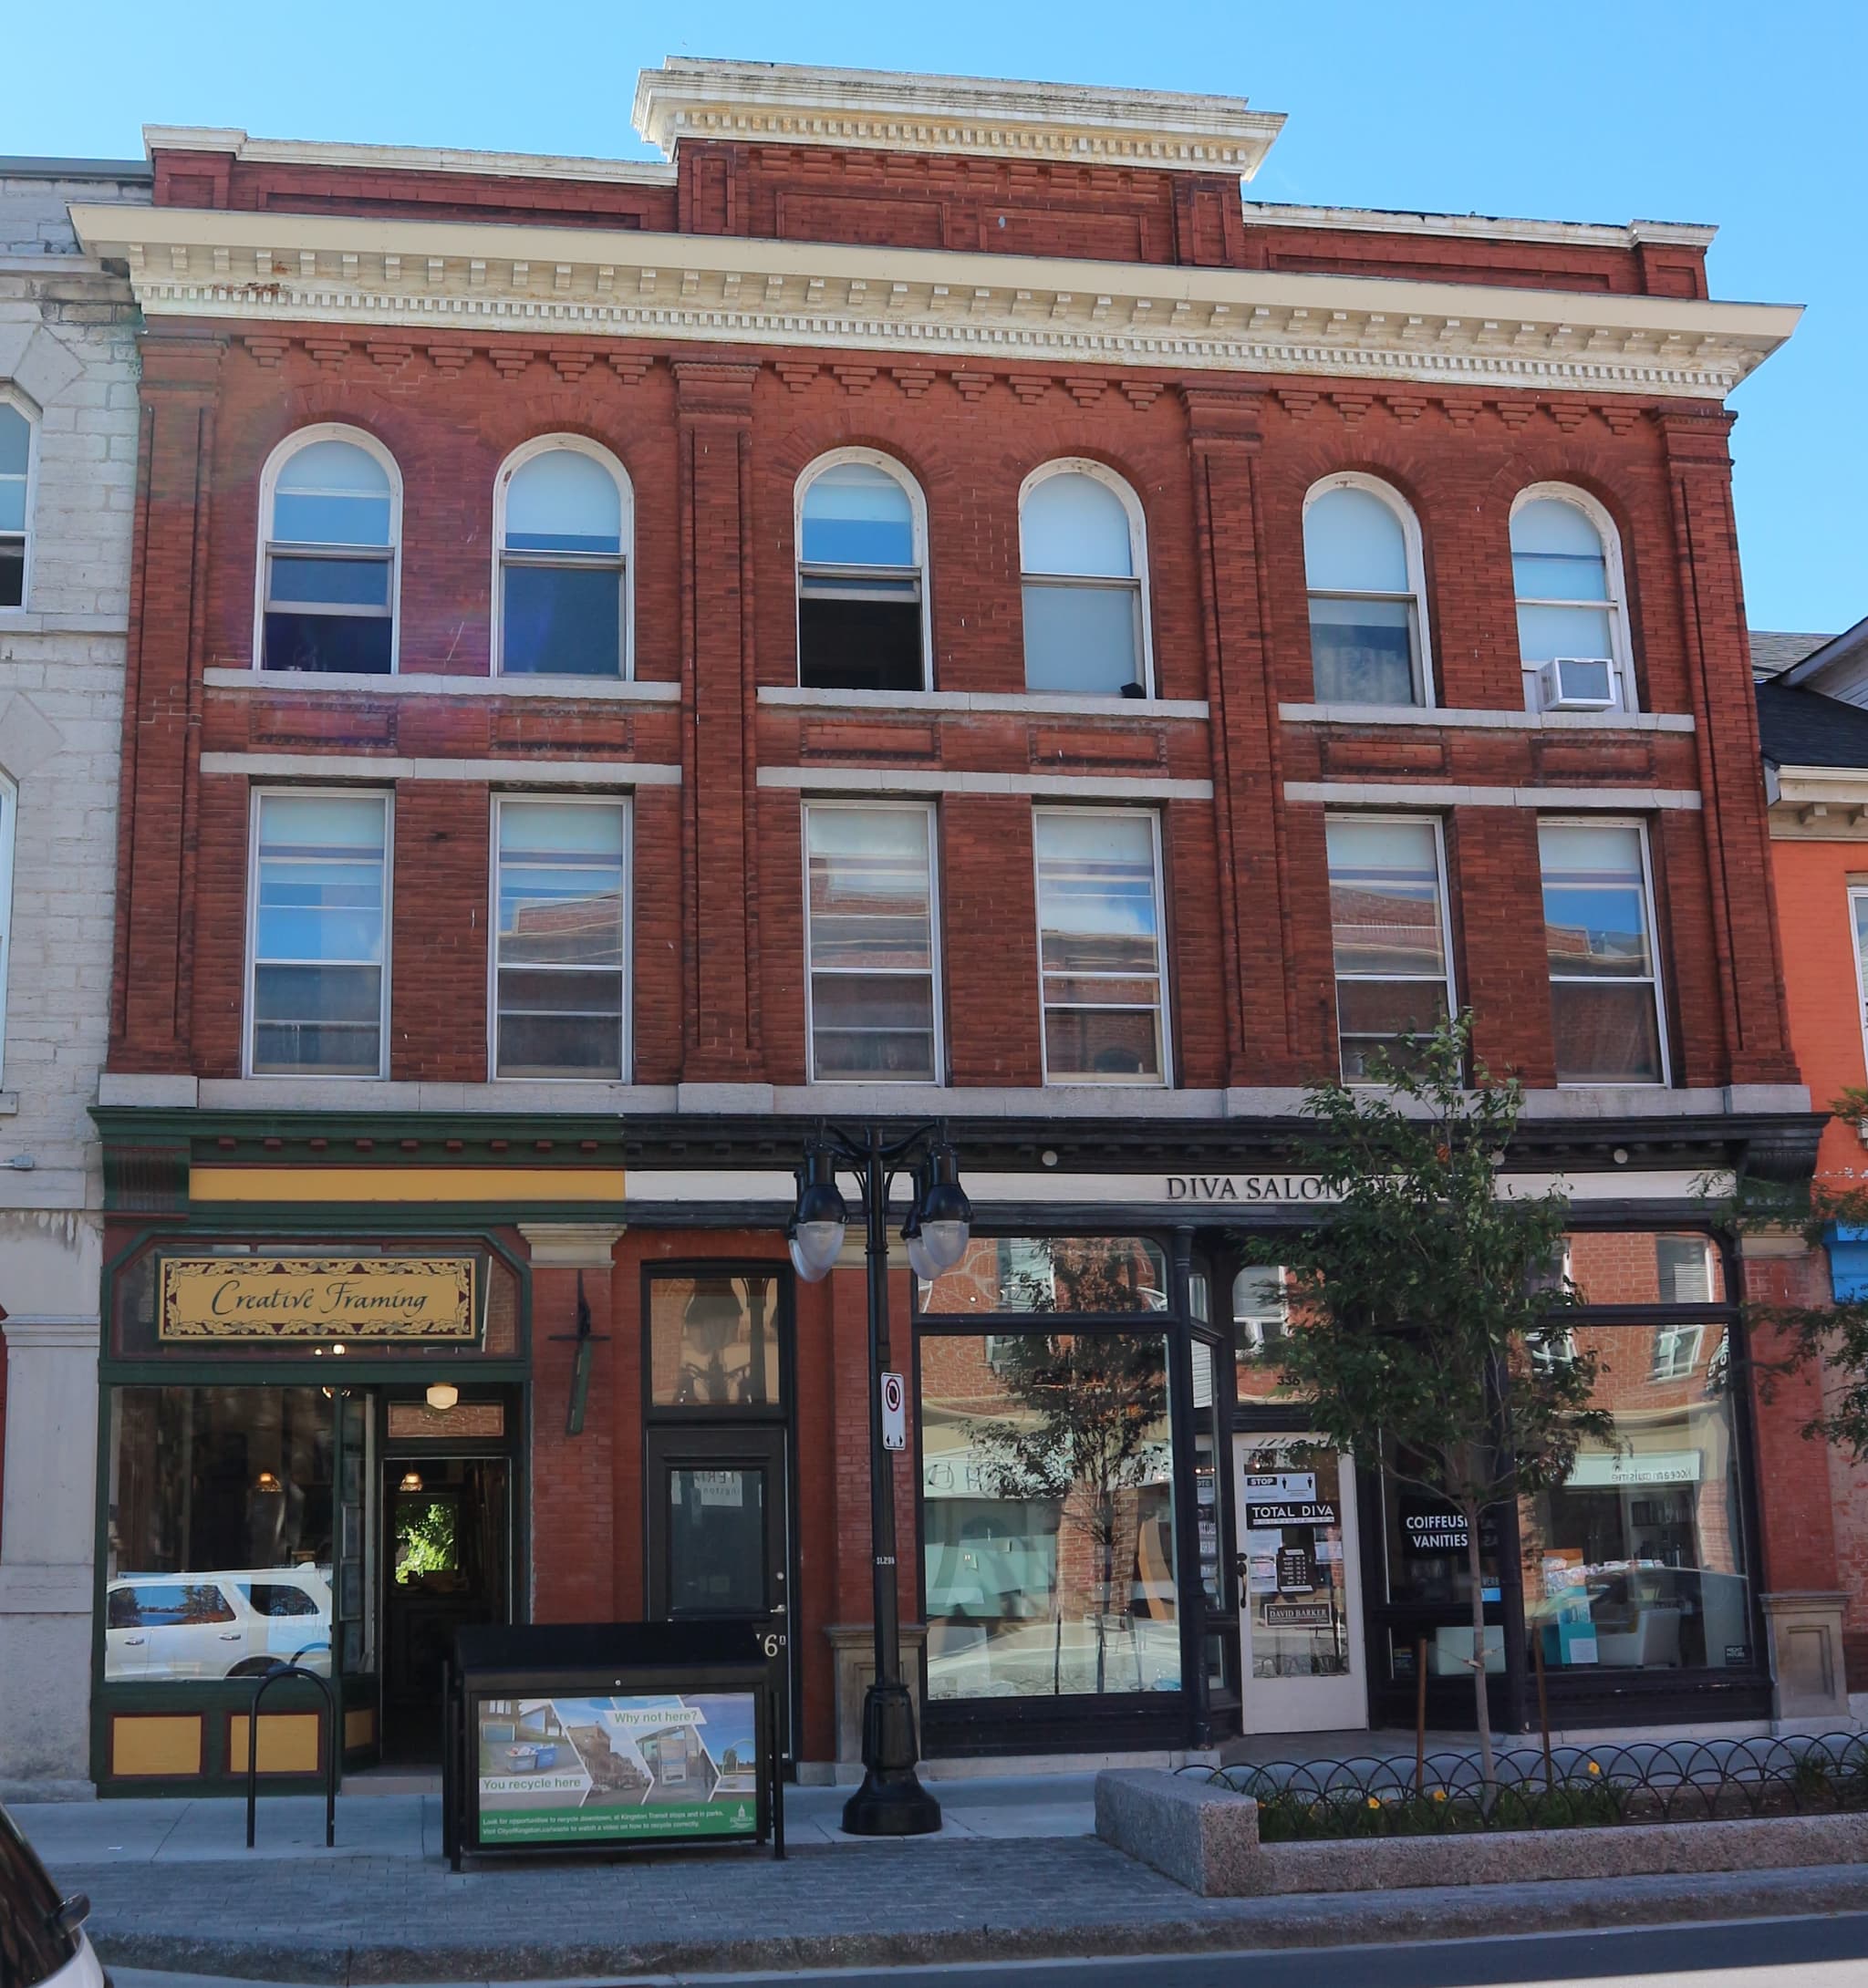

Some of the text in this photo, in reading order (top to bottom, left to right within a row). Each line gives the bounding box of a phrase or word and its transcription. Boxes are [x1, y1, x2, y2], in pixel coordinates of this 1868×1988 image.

[1167, 1177, 1343, 1200] DIVA SALON
[212, 1279, 429, 1318] Creative Framing
[1251, 1477, 1274, 1486] STOP
[1251, 1505, 1334, 1518] TOTAL DIVA
[1413, 1534, 1468, 1548] VANITIES
[1270, 1609, 1326, 1619] DAVID BARKER
[615, 1711, 697, 1724] Why not here?
[483, 1777, 581, 1790] You recycle here
